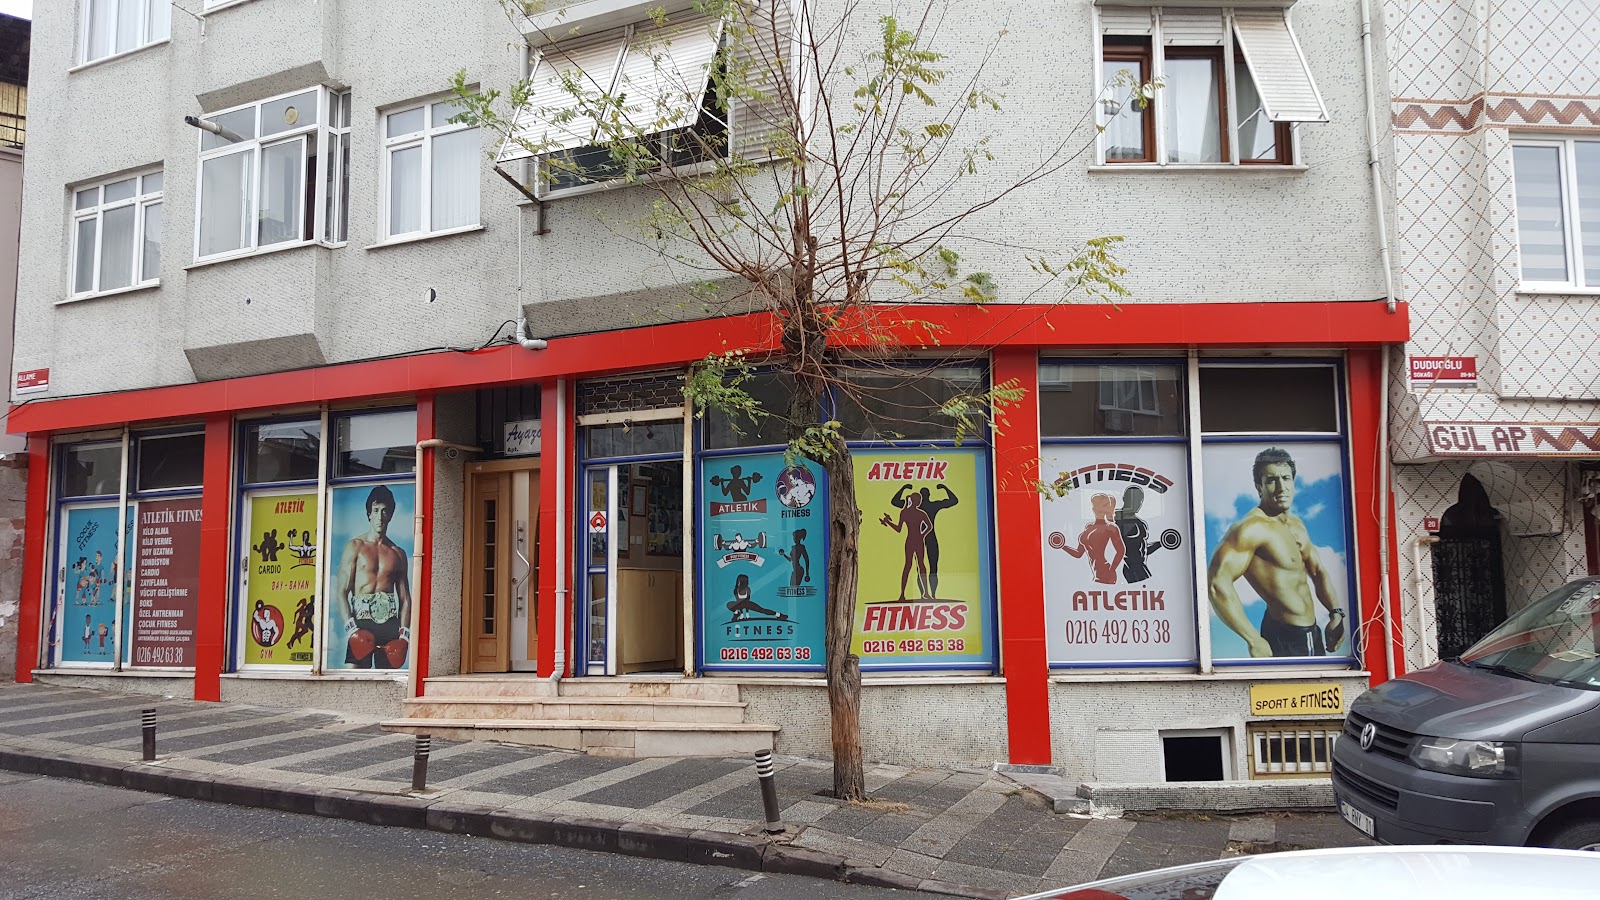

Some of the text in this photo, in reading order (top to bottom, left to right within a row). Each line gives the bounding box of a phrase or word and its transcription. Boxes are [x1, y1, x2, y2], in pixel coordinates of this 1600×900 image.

[1432, 426, 1526, 452] GÜL AP
[868, 456, 948, 480] ATLETİK
[275, 498, 304, 514] ATLETİK
[719, 502, 758, 513] ATLETİK
[141, 508, 174, 524] ATLETİK
[781, 509, 810, 518] FITNESS
[79, 522, 99, 551] FITNESS
[143, 527, 154, 535] KİLO
[155, 527, 169, 535] ALMA
[142, 537, 172, 545] KİLO VERME
[142, 548, 152, 556] BOY
[141, 557, 170, 566] KONDİSYON
[141, 568, 160, 576] CARDIO
[259, 565, 281, 574] CARDIO
[272, 581, 283, 590] BAY
[289, 580, 309, 590] BAYAN
[140, 587, 188, 598] VÜCUT GELİŞTİRME
[1072, 584, 1165, 611] ATLETİK
[139, 609, 151, 617] ÖZEL
[863, 604, 968, 632] FITNESS
[139, 620, 177, 629] ÇOCUK FITNESS
[726, 625, 794, 635] FITNESS
[1066, 620, 1170, 644] 0216 492 63 38
[863, 638, 964, 653] 0216 492 63 38
[137, 647, 183, 663] 0216 492 63 38
[260, 649, 273, 659] GYM
[720, 647, 811, 660] 0216 492 63 38
[1256, 687, 1340, 710] SPORT & FITNESS
